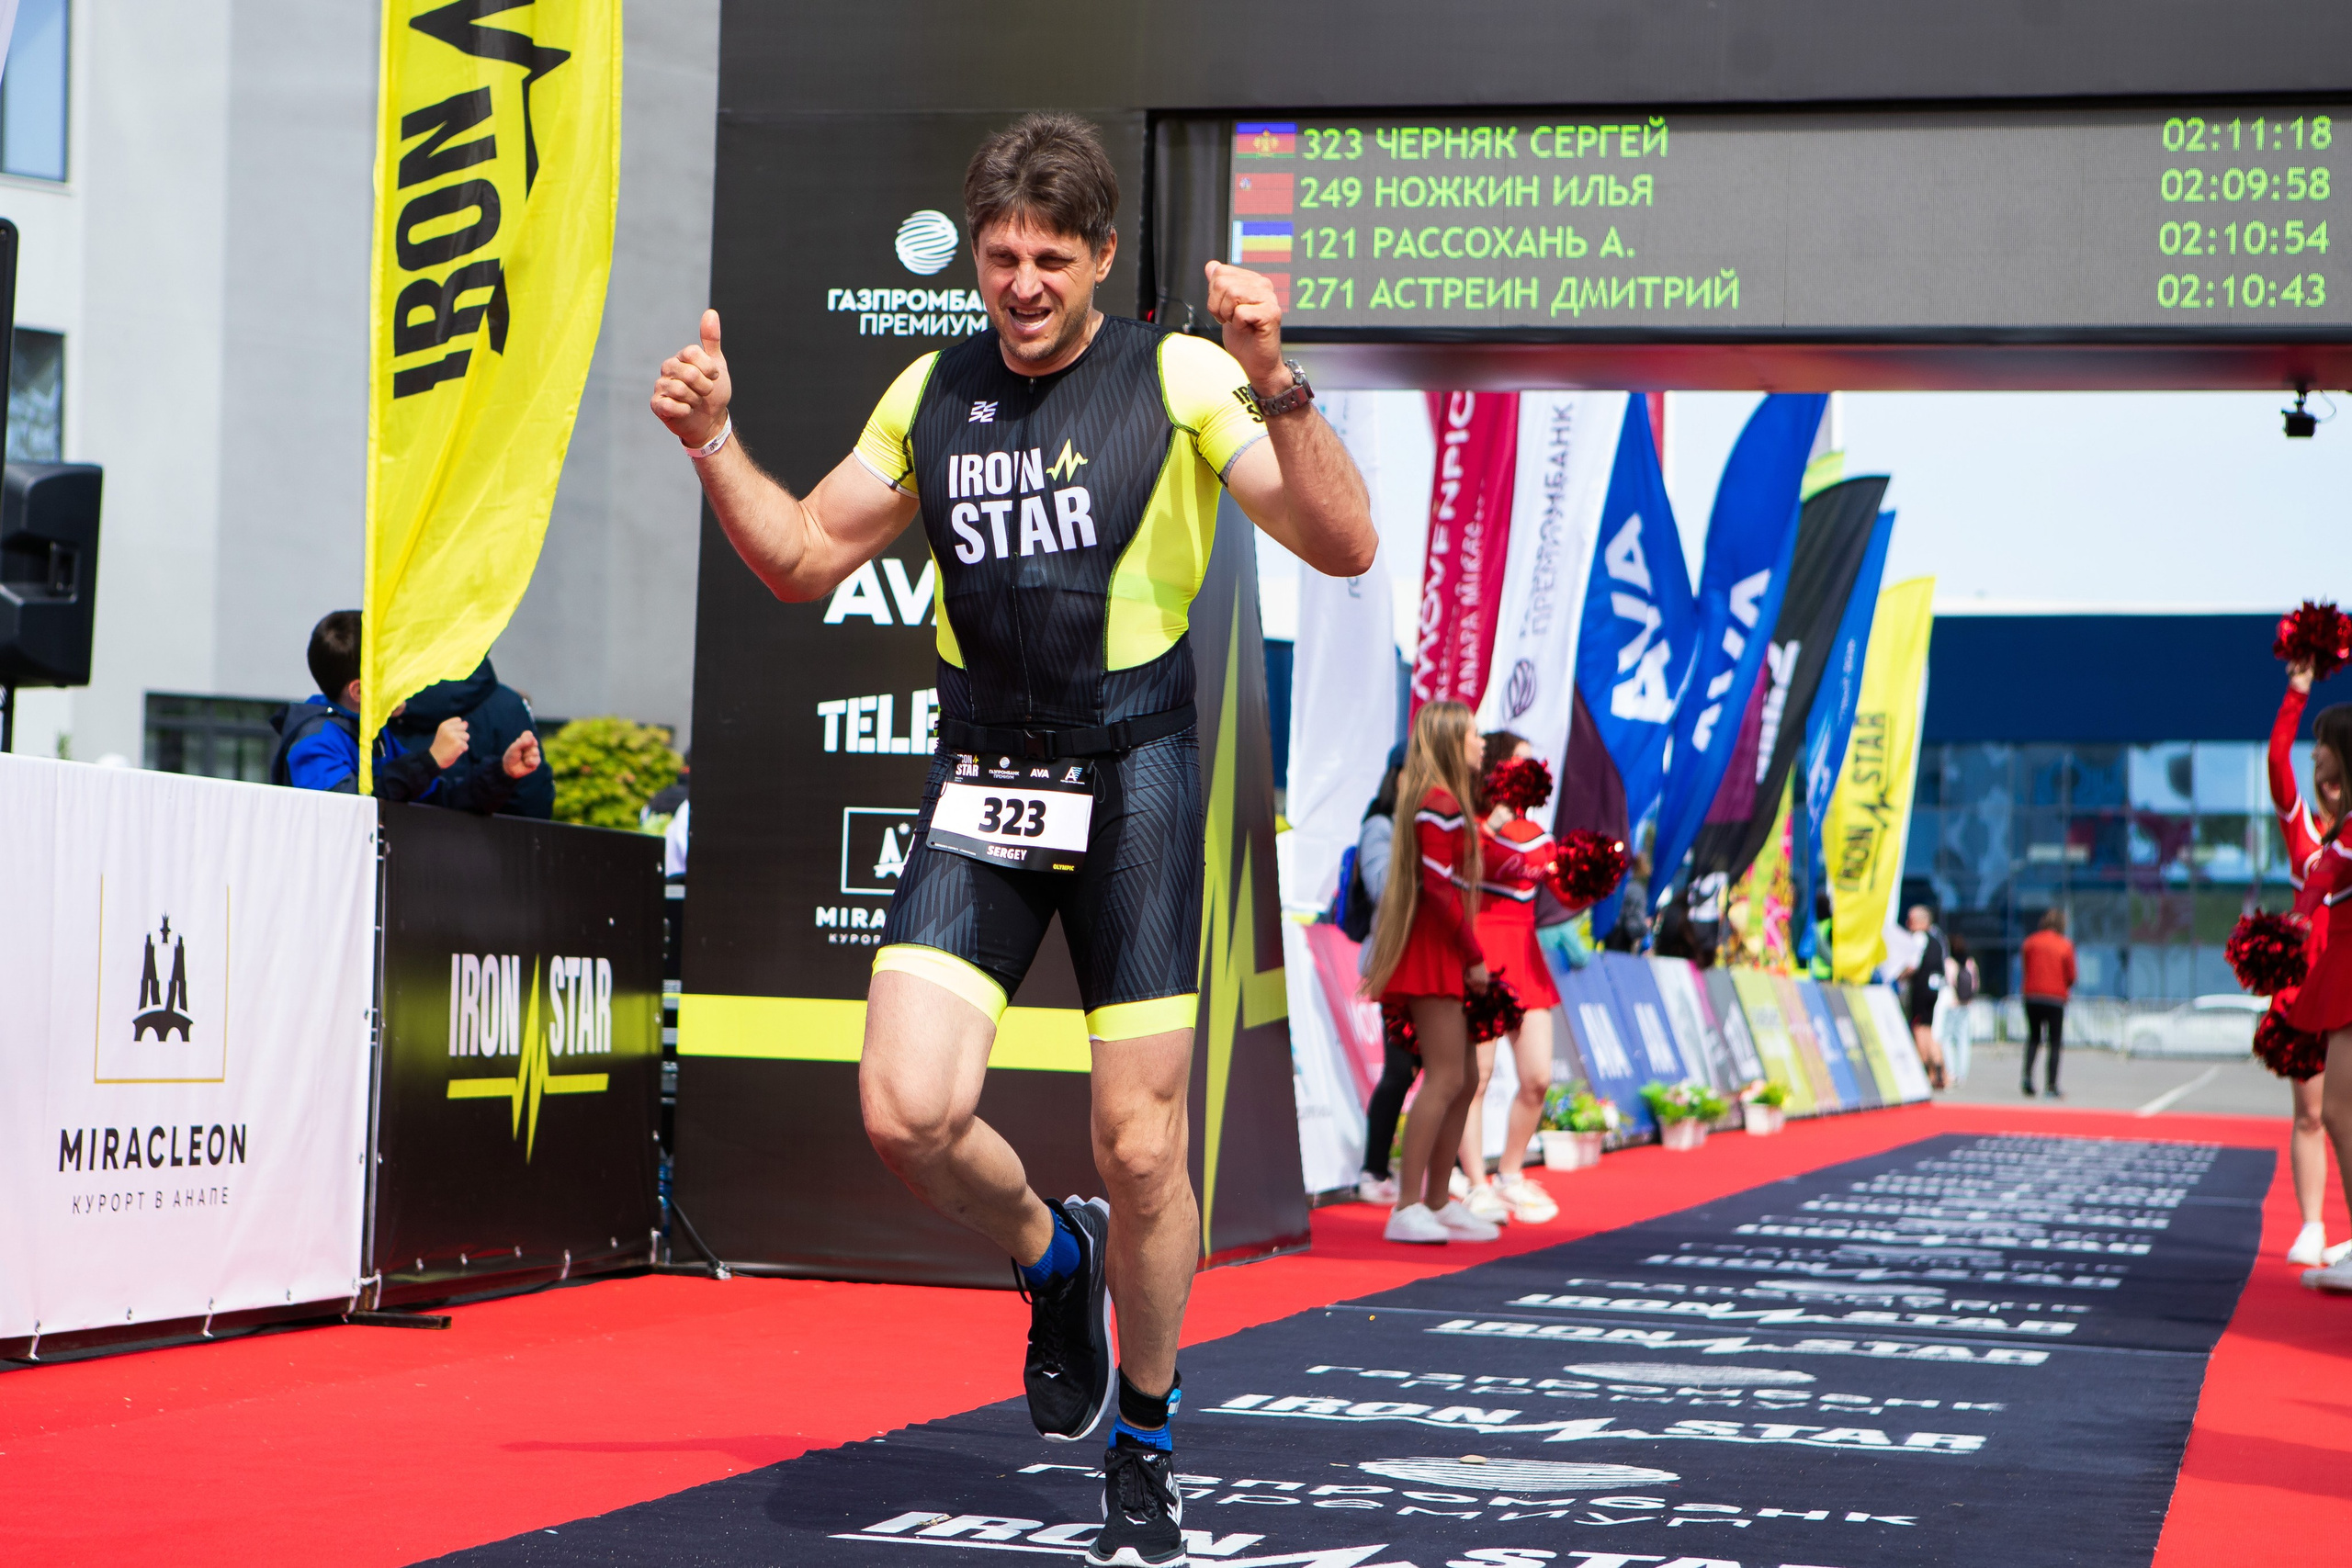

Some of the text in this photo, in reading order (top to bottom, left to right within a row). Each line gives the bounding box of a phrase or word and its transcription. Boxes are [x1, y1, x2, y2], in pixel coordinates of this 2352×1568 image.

[1303, 115, 2333, 161] 323 ЧЕРНЯК СЕРГЕЙ 02:11:18
[1299, 166, 2332, 209] 249 НОЖКИН ИЛЬЯ 02:09:58
[1301, 219, 2331, 260] 121 РАССОХАНЬ А. 02:10:54
[827, 288, 988, 312] ГАЗПРОМБА
[1296, 267, 2326, 318] 271 АСТРЕИН ДМИТРИЙ 02:10:43
[859, 312, 989, 337] ПРЕМИУМ
[1232, 384, 1250, 405] IR
[949, 447, 1046, 499] IRON
[950, 486, 1098, 565] STAR
[822, 558, 937, 626] AV
[1603, 513, 1674, 725] AVA
[955, 763, 979, 777] STAR
[1030, 768, 1050, 779] AVA
[978, 796, 1046, 838] 323
[986, 844, 1028, 862] SERGEY
[1052, 863, 1075, 872] OLYMPIC
[448, 953, 614, 1058] IRON STAR
[59, 1123, 247, 1173] MIRACLEON
[72, 1186, 230, 1215] КУРОРТ В АНАПЕ
[1219, 1393, 1987, 1451] IRON STAR
